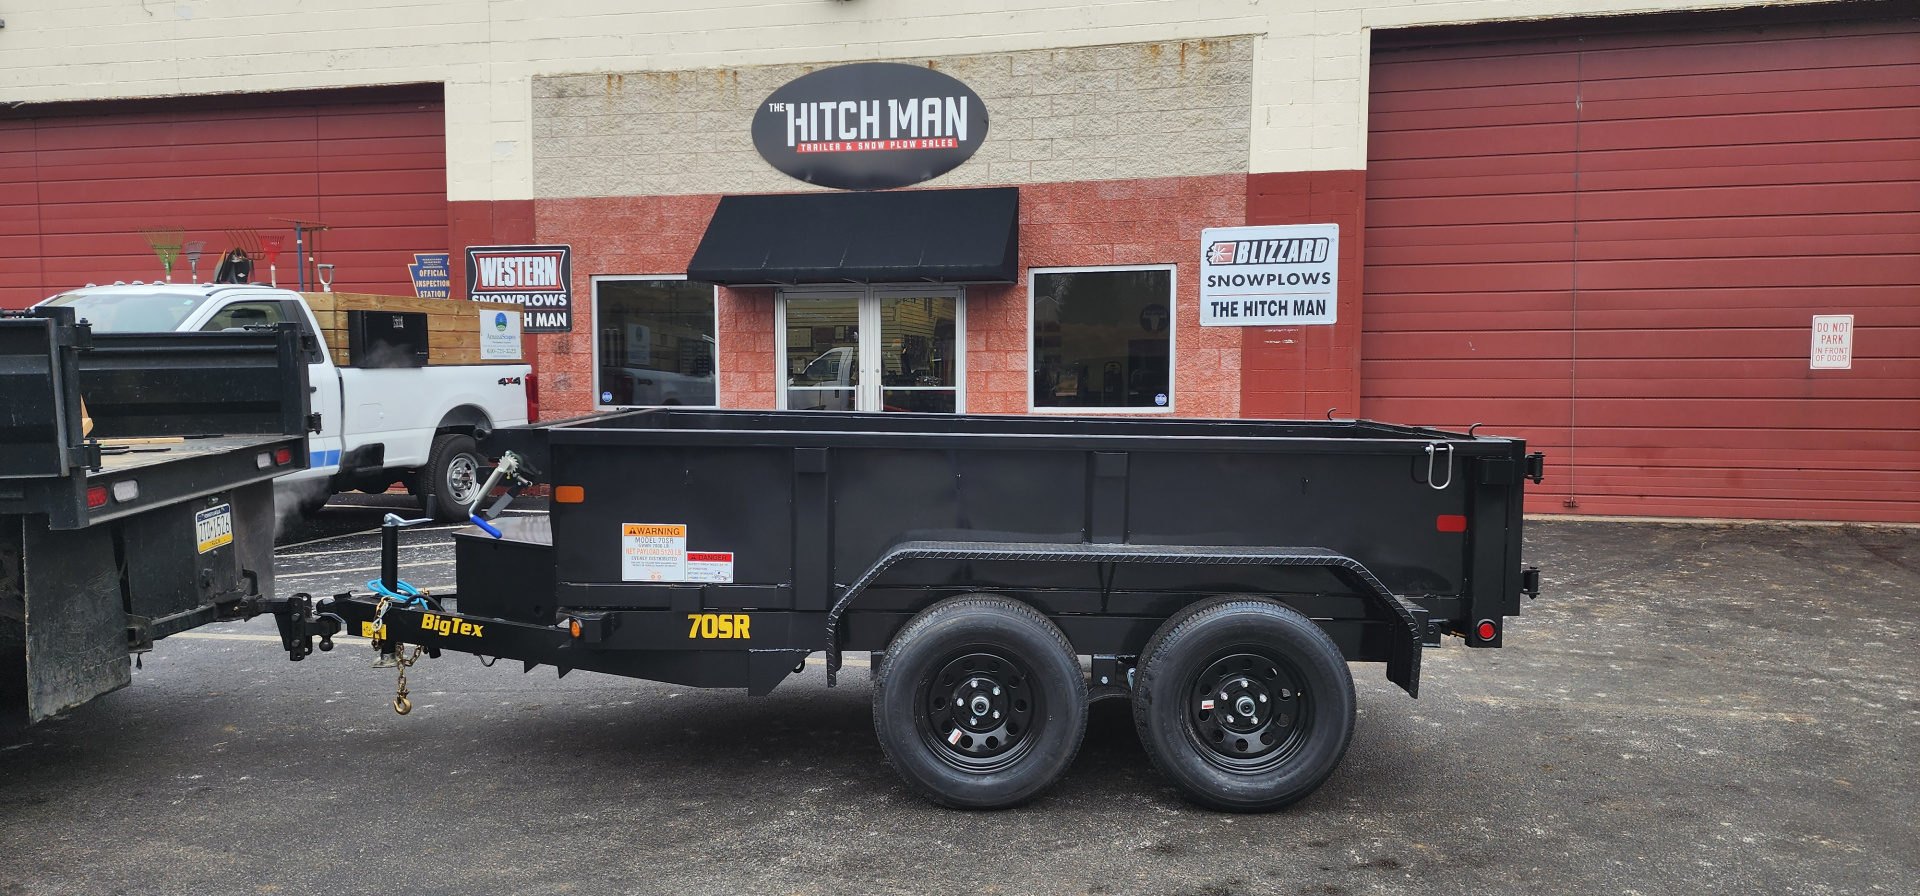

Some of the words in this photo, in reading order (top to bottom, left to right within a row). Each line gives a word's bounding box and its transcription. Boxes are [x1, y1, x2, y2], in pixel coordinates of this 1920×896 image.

[768, 102, 784, 112] THE
[786, 100, 880, 146] HITCH
[888, 96, 968, 141] MAN
[858, 142, 885, 150] SNOW
[890, 140, 916, 149] PLOW
[922, 139, 953, 147] SALES
[1236, 239, 1328, 264] BLIZZARD
[480, 256, 557, 287] WESTERN
[1207, 272, 1330, 287] SNOWPLOWS
[1211, 301, 1238, 317] THE
[1244, 300, 1288, 316] HITCH
[1293, 299, 1326, 316] MAN
[536, 313, 566, 326] MAN
[1818, 323, 1828, 332] DO
[1833, 323, 1849, 332] NOT
[1821, 335, 1843, 344] PARK
[421, 614, 485, 638] BigTex
[688, 614, 750, 638] 70SR
